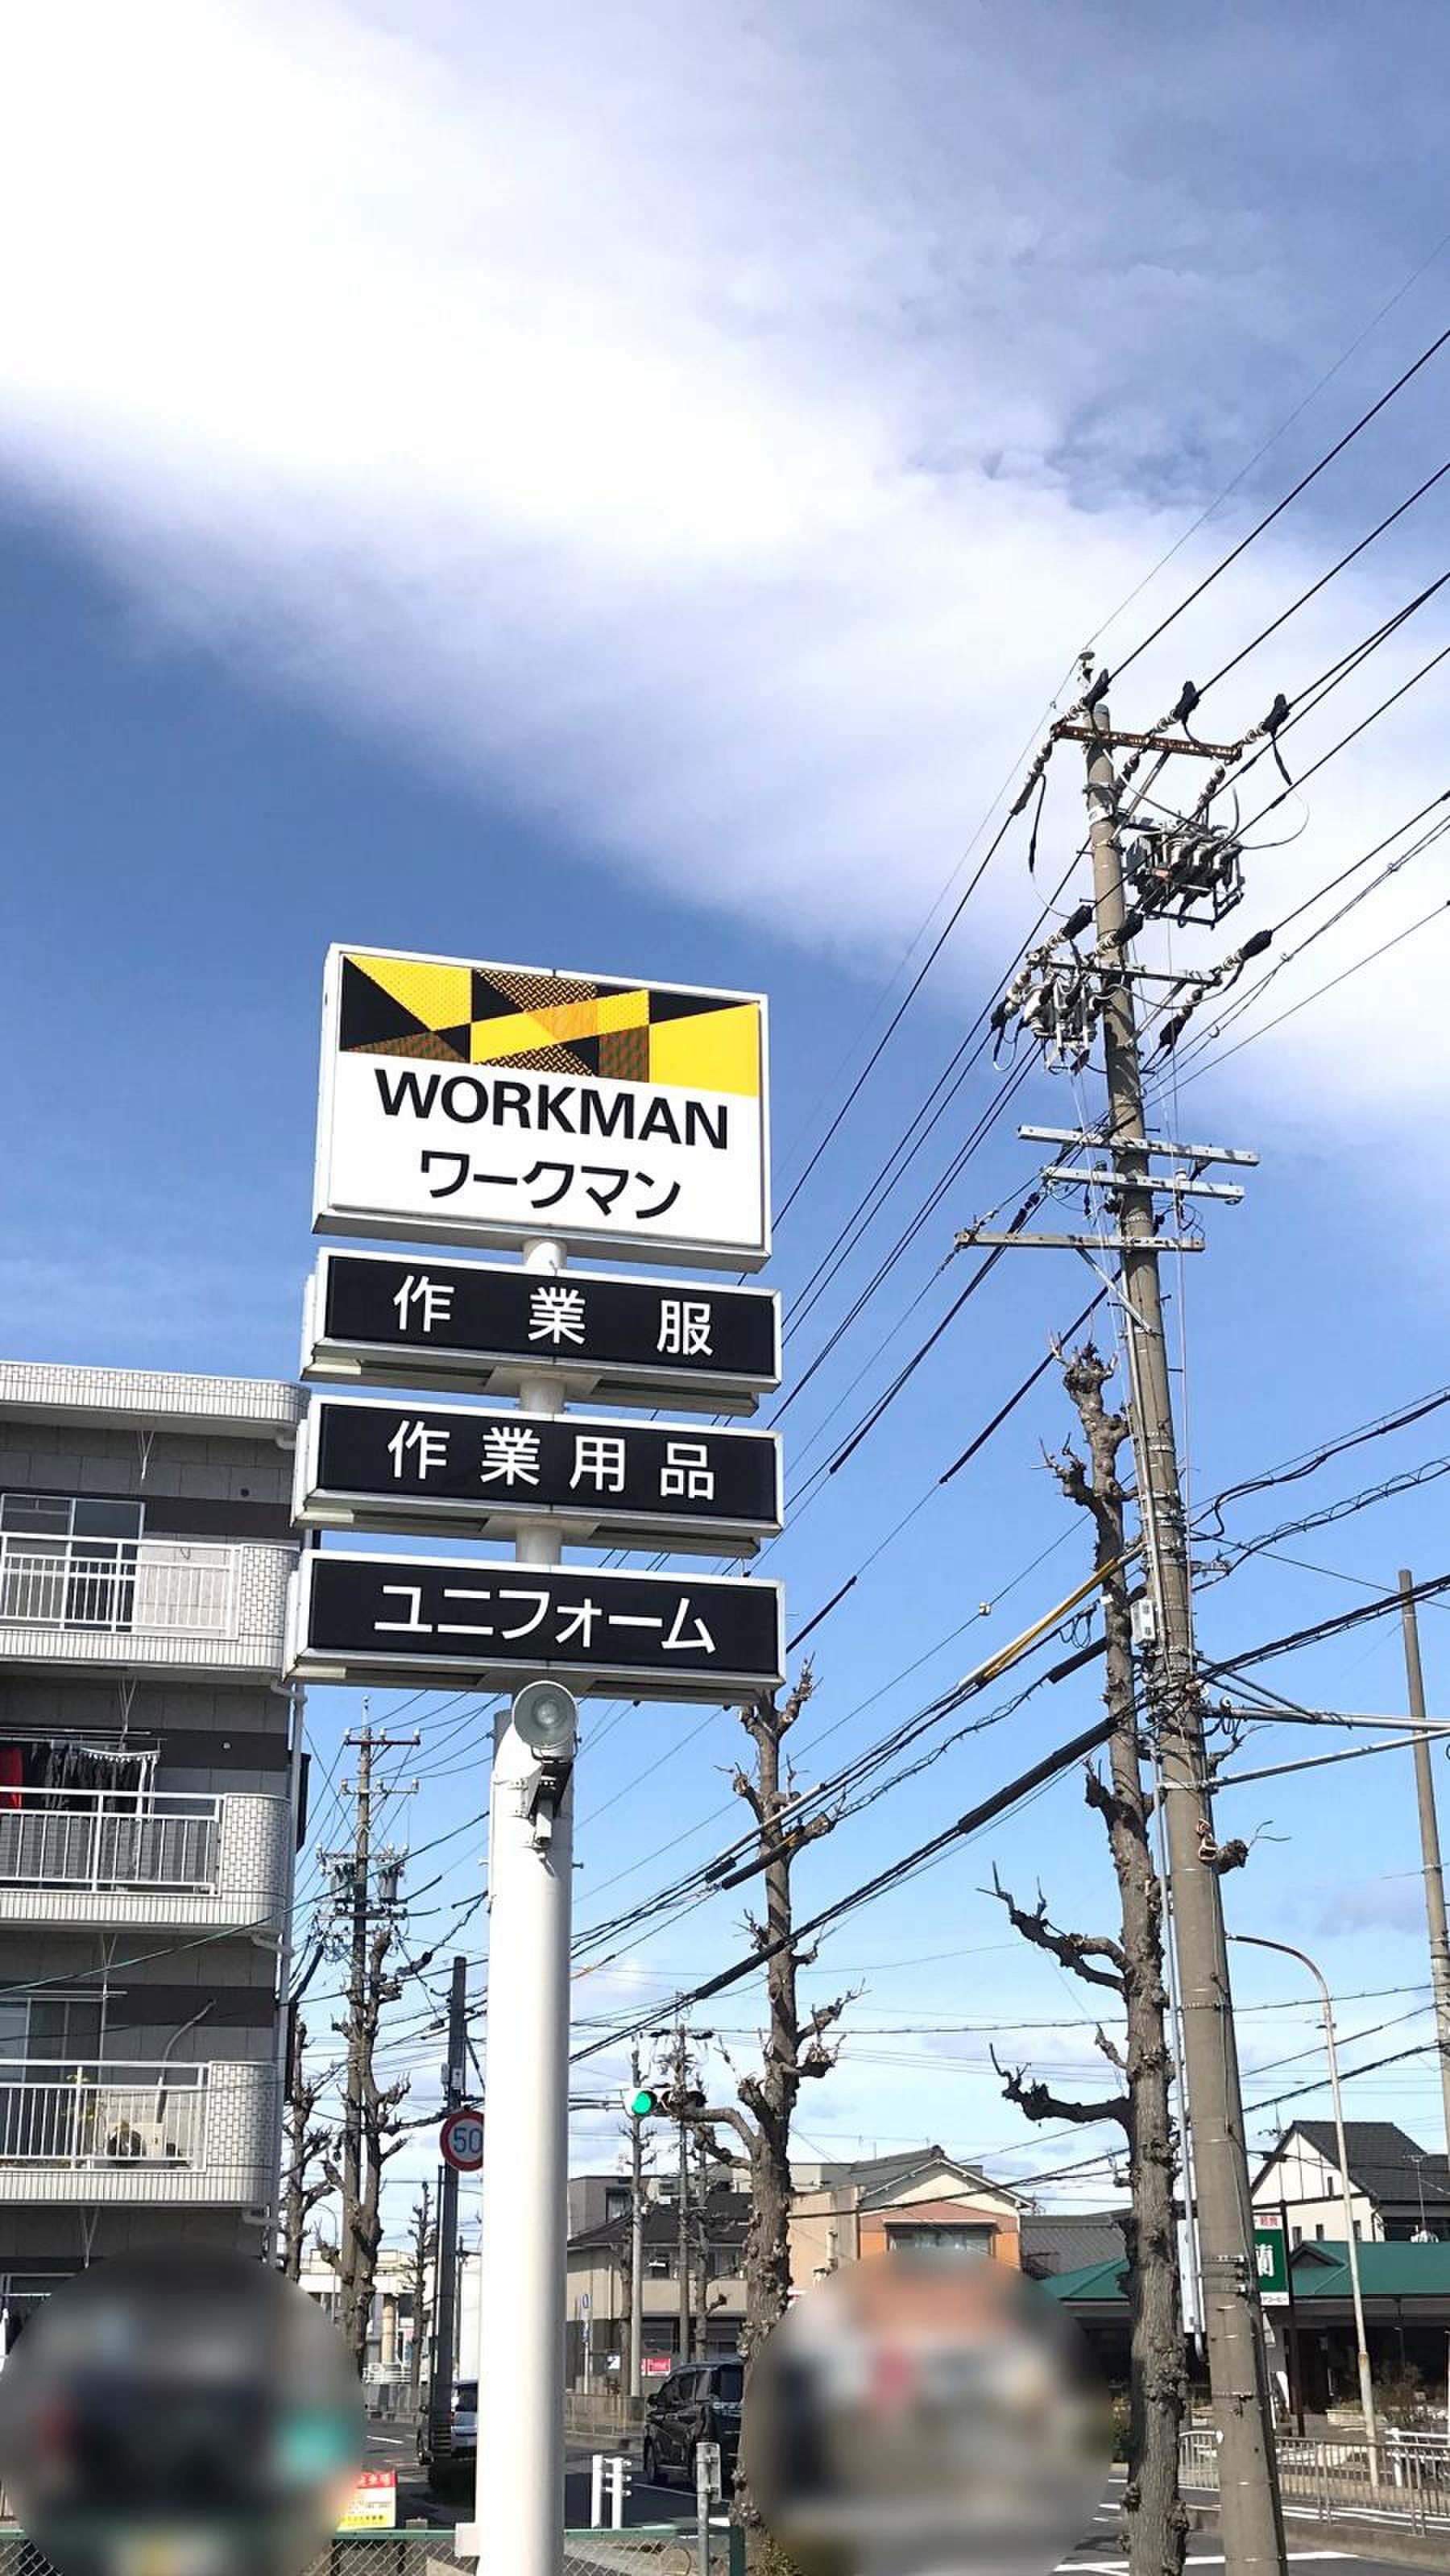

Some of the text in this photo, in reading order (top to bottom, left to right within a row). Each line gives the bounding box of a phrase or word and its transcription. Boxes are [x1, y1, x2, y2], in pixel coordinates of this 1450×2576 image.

[374, 1069, 727, 1150] WORKMAN
[420, 1149, 681, 1220] ワークマン
[392, 1274, 714, 1356] 作業服
[387, 1419, 715, 1501] 作業用品
[374, 1584, 716, 1654] ユニフォーム
[454, 2127, 483, 2153] 50
